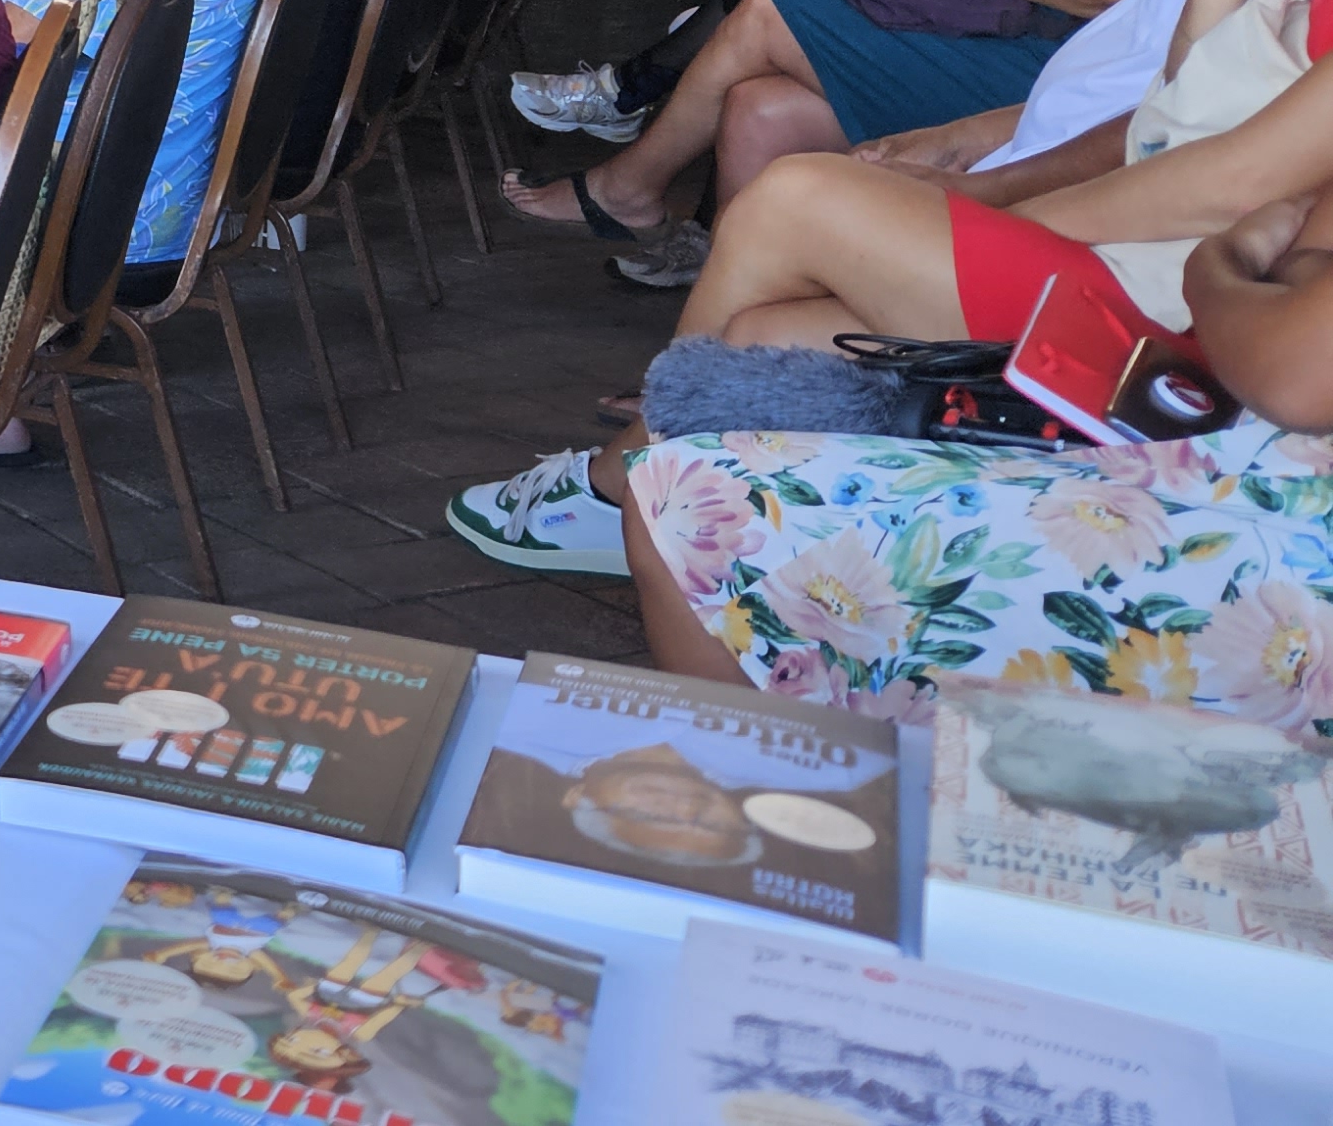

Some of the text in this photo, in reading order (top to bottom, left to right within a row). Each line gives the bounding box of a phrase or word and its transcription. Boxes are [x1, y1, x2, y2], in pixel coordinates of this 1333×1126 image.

[127, 627, 227, 654] PEINE
[238, 641, 282, 662] SA
[294, 652, 428, 691] PORTER
[252, 692, 408, 738] AMO
[953, 852, 1161, 900] LA FEMME
[955, 835, 1160, 884] PARIHAKA
